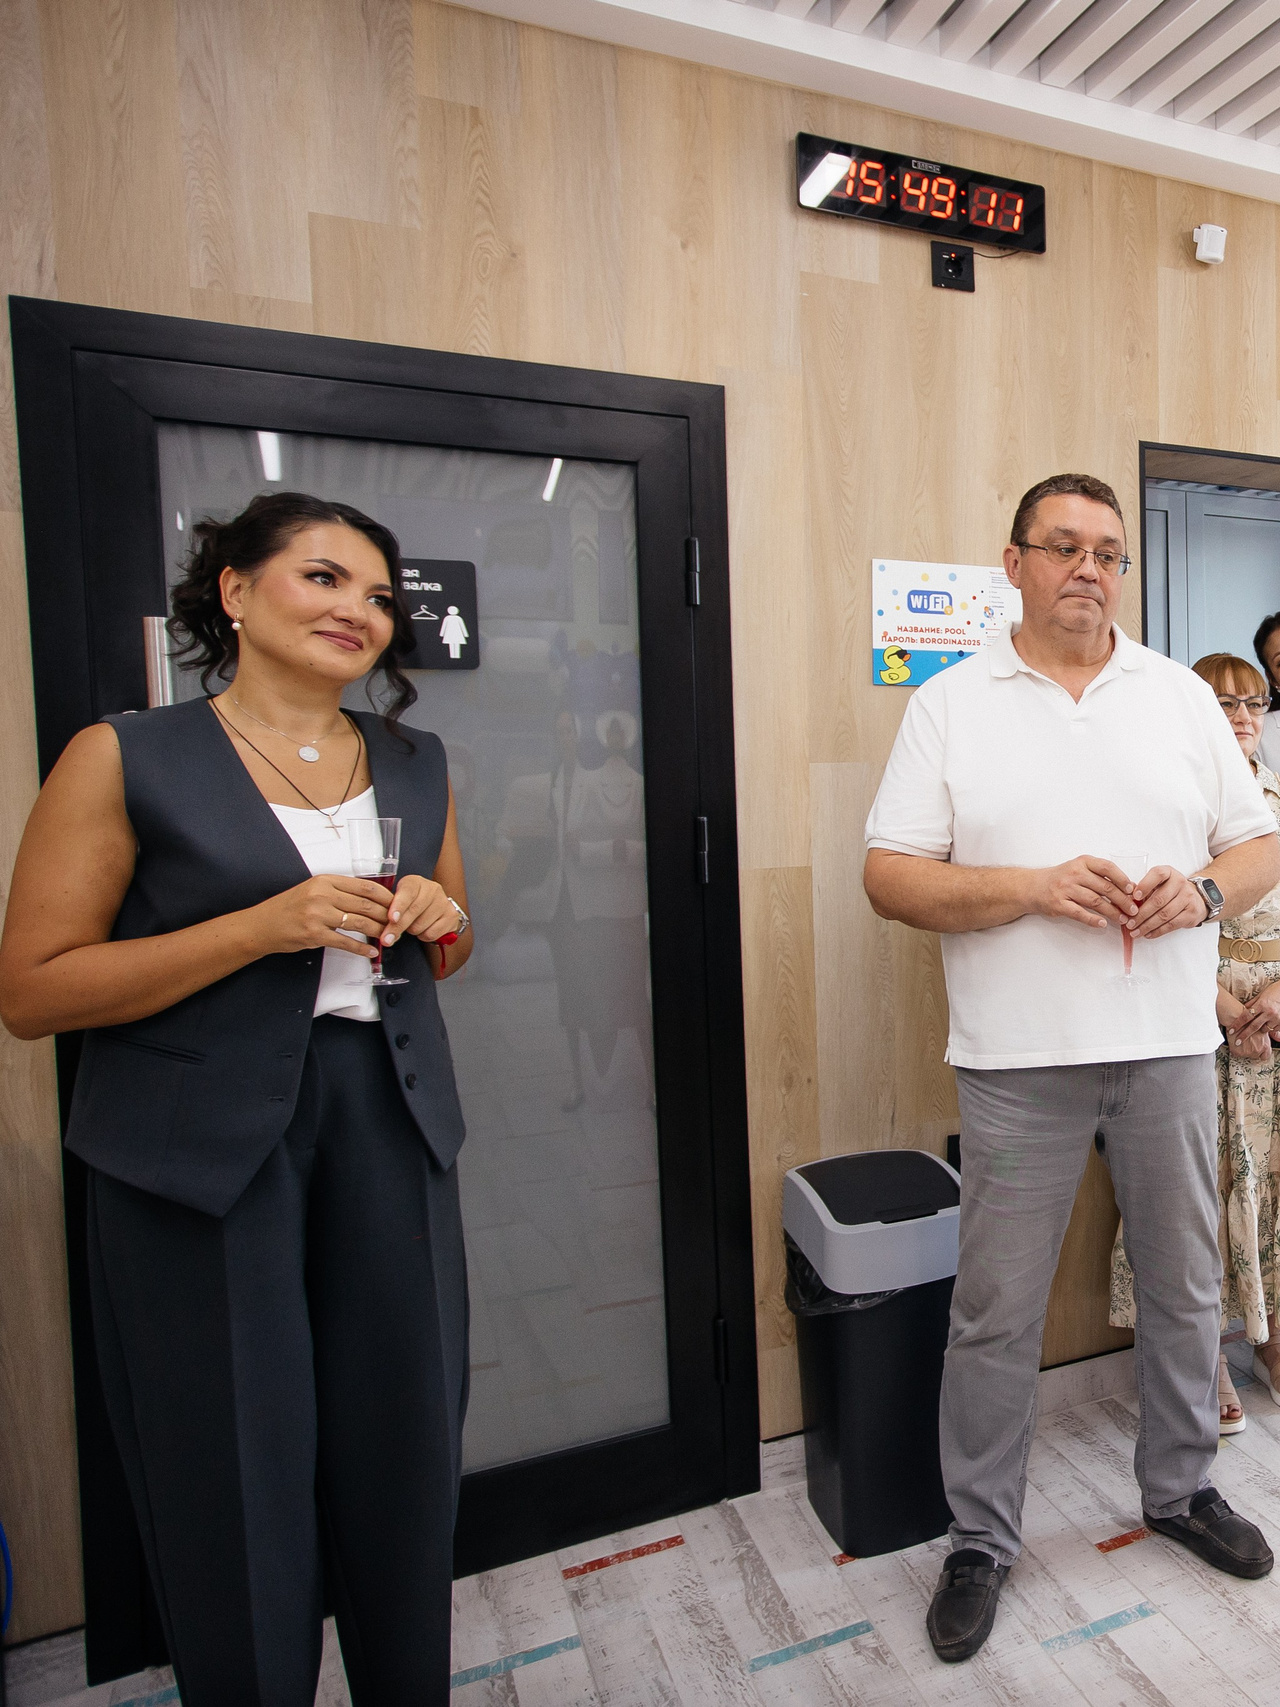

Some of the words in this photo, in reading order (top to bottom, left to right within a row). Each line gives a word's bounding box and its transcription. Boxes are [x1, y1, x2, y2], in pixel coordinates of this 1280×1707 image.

[401, 568, 420, 578] ая
[402, 581, 443, 591] валка
[897, 625, 943, 635] НАЗВАНИЕ:
[944, 627, 966, 635] POOL
[881, 635, 919, 644] ПАРОЛЬ:
[920, 637, 981, 646] BORODINA2025
